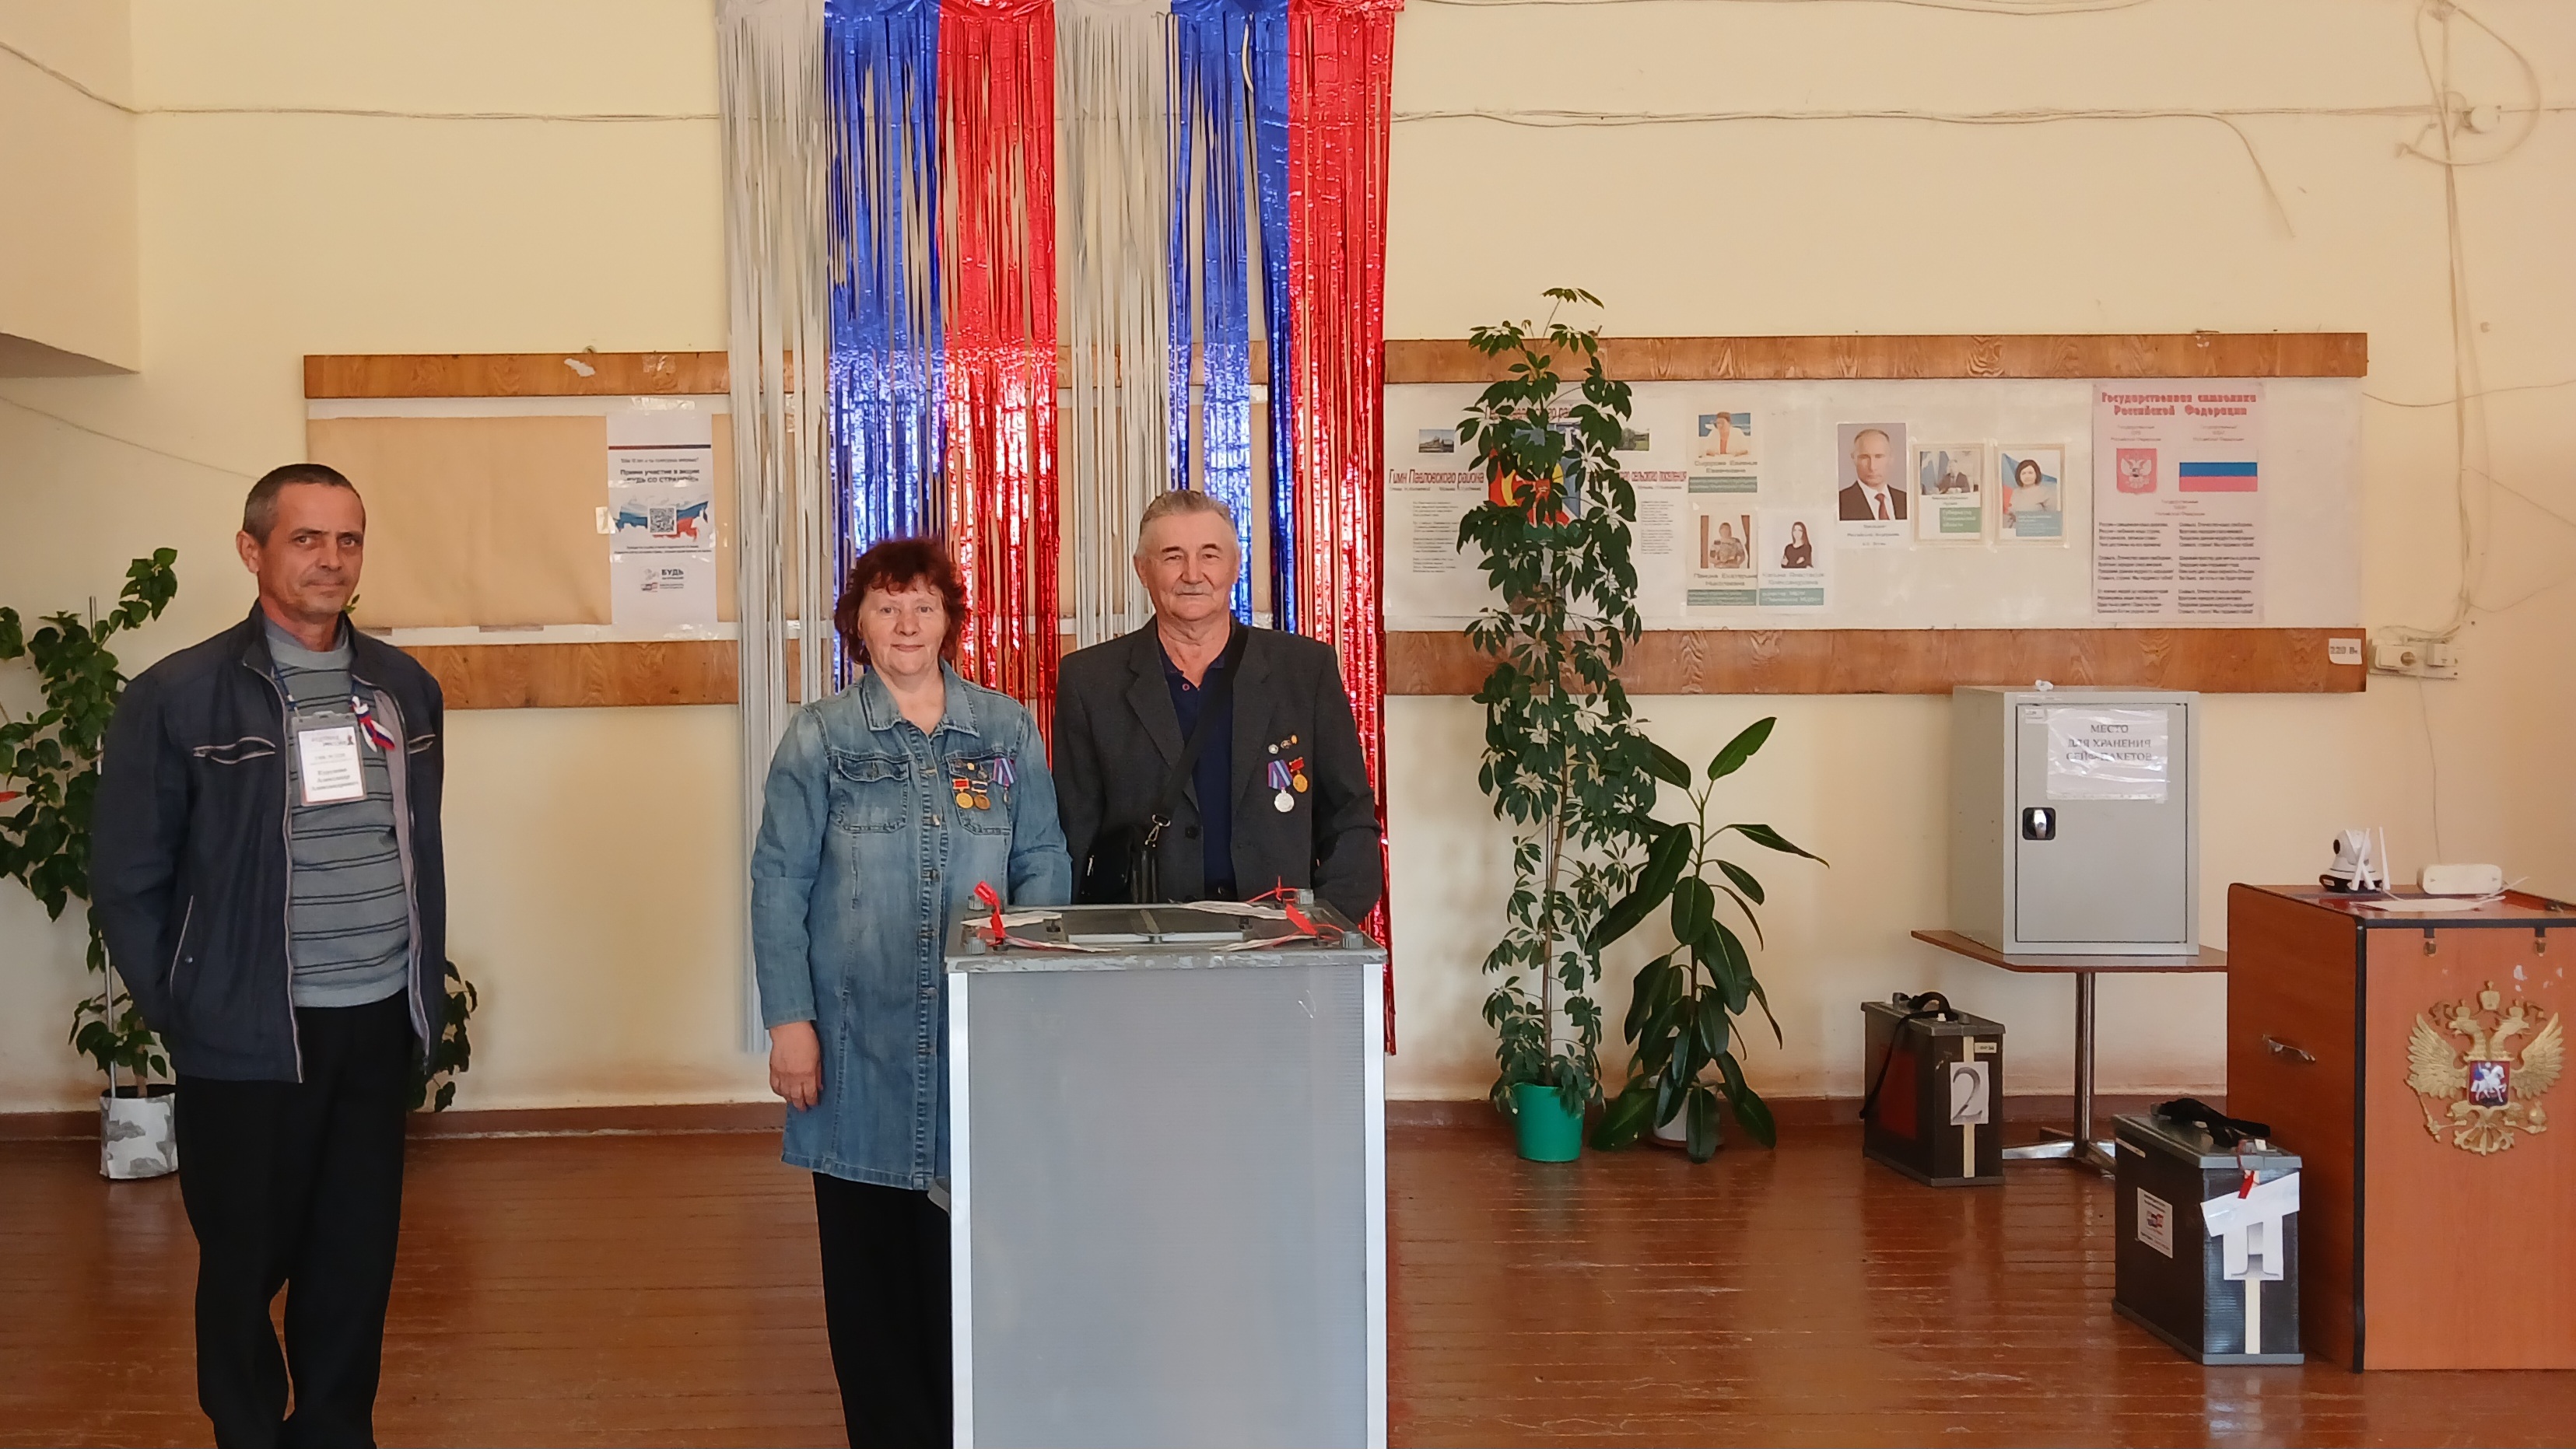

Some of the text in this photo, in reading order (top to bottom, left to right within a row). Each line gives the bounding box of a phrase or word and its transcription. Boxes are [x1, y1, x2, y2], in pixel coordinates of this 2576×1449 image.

[2102, 392, 2256, 404] Государственная символика
[2114, 404, 2247, 418] Российской Федерации
[1389, 469, 1484, 490] Гимн Павловского района
[2090, 724, 2129, 733] МЕСТО
[2068, 739, 2152, 747] ДЛЯ ХРАНЕНИЯ
[1952, 1066, 1982, 1123] 2
